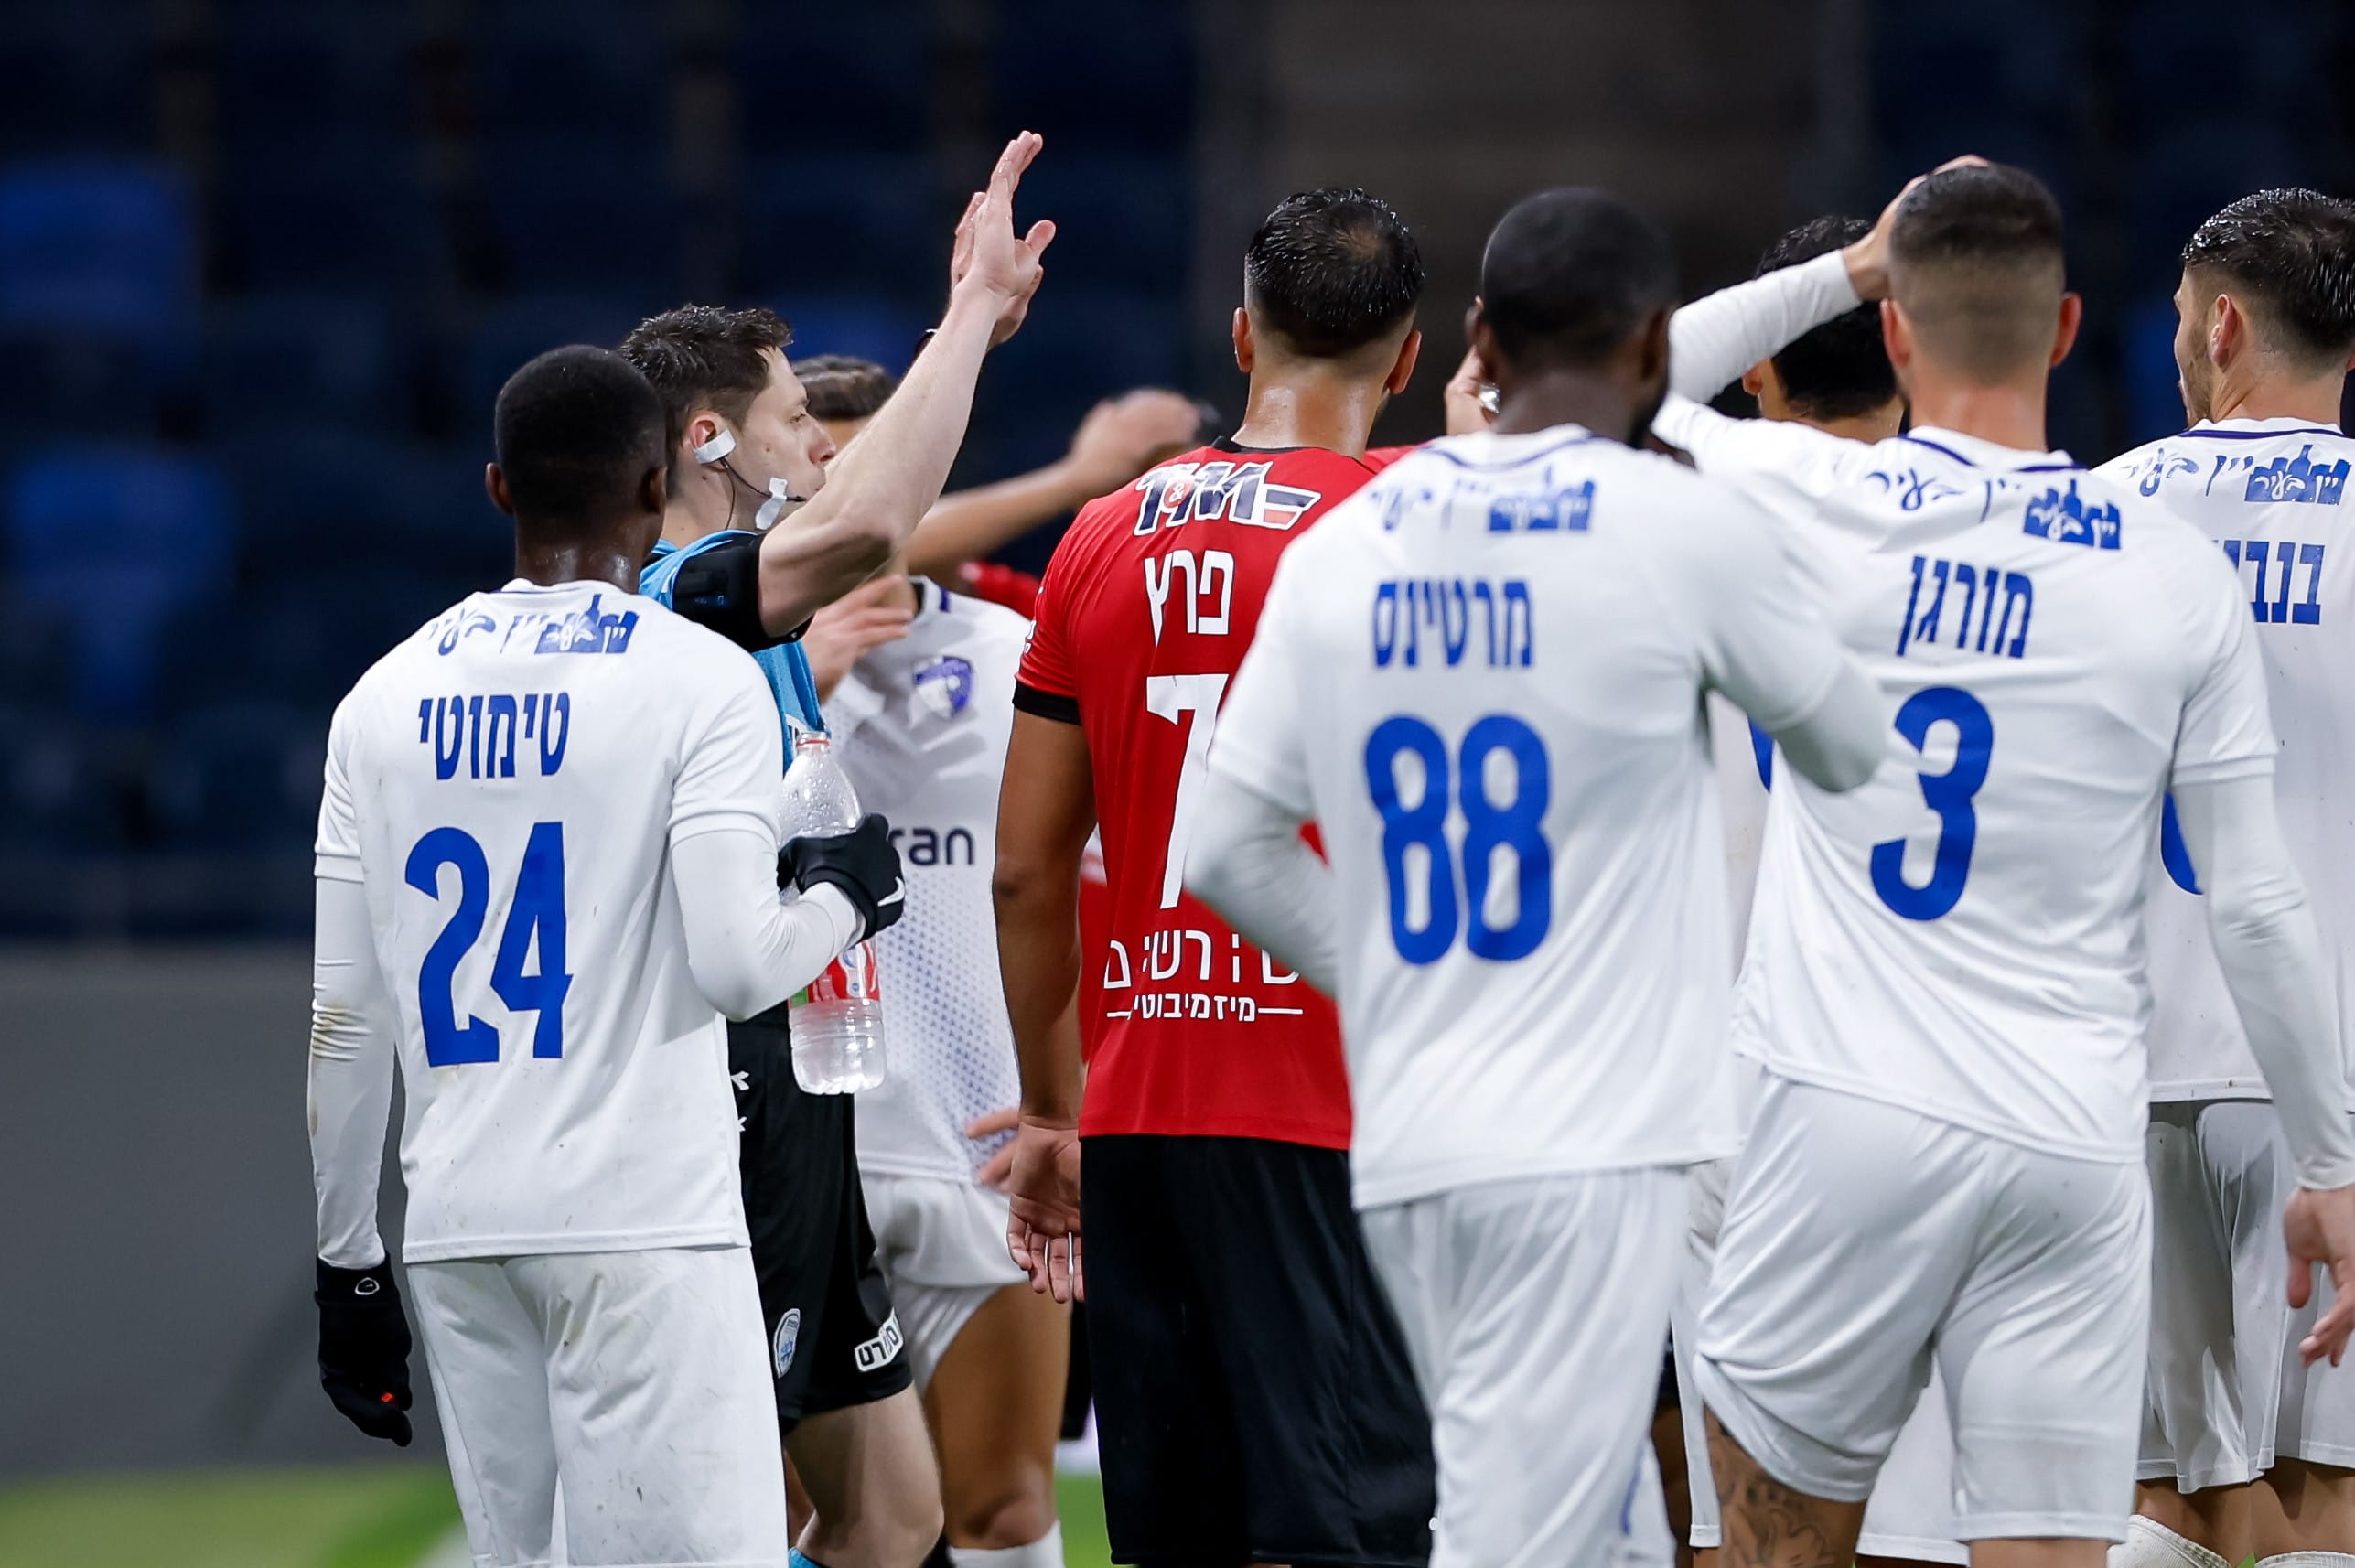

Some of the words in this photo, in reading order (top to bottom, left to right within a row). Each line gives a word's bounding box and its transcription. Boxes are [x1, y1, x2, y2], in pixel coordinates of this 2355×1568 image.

[1144, 549, 1236, 648] פרץ
[1374, 579, 1534, 669] מרטינס
[1897, 555, 2034, 659] מורגן
[419, 692, 570, 780] טימוטי
[1146, 673, 1230, 909] 7
[1870, 684, 1995, 921] 3
[1363, 714, 1553, 967] 88
[405, 822, 573, 1067] 24
